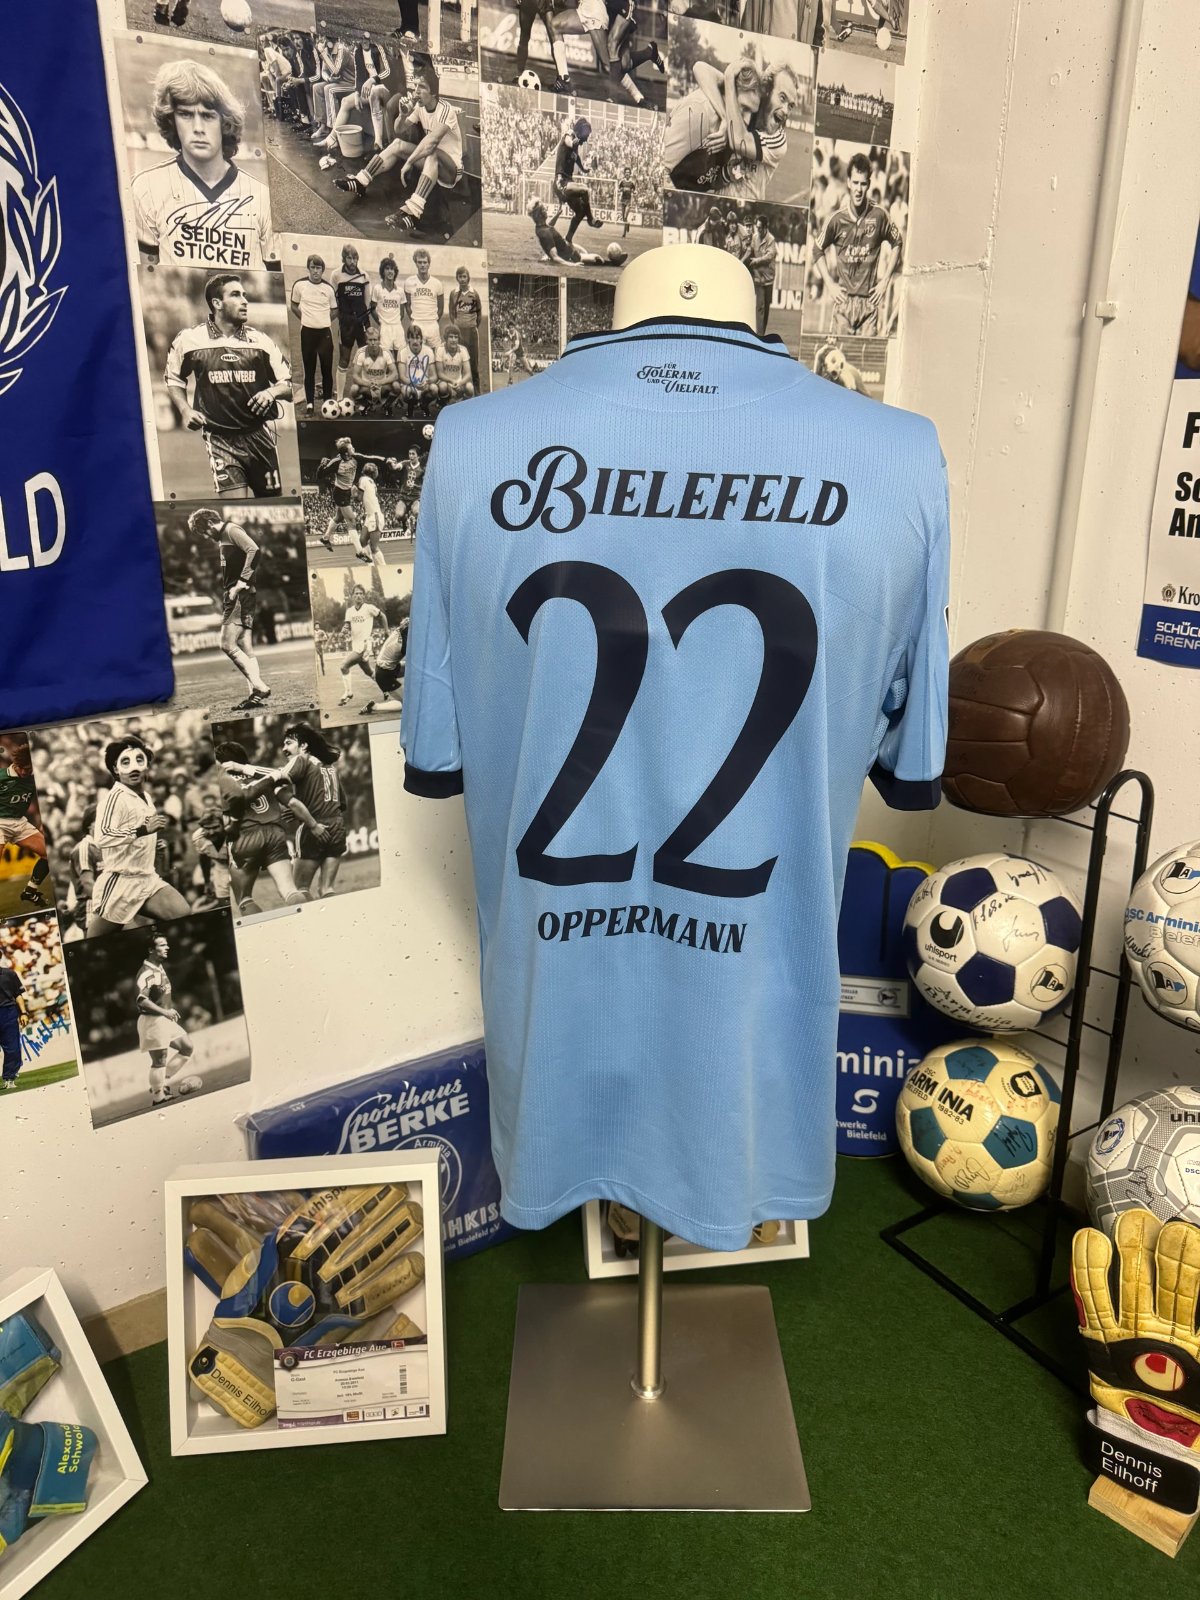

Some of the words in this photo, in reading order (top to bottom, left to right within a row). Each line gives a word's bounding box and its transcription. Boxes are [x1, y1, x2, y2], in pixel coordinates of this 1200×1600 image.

[181, 223, 246, 250] SEIDEN
[173, 240, 251, 266] STICKER
[208, 370, 233, 384] GERRY
[233, 370, 256, 383] WEBER
[264, 469, 281, 490] 11
[490, 445, 849, 533] BIELEFELD
[505, 560, 818, 897] 22
[537, 904, 748, 954] OPPERMANN
[924, 943, 958, 963] uhlsport
[349, 1093, 470, 1153] BERKE
[847, 1129, 887, 1141] Bielefeld
[414, 1138, 452, 1159] Arminia
[303, 1350, 315, 1360] FC
[317, 1345, 367, 1358] Erzgebirge
[369, 1344, 387, 1352] Aue
[210, 1368, 243, 1398] Dennis
[1100, 1440, 1162, 1478] Dennis
[1102, 1456, 1159, 1493] Eilhoff
